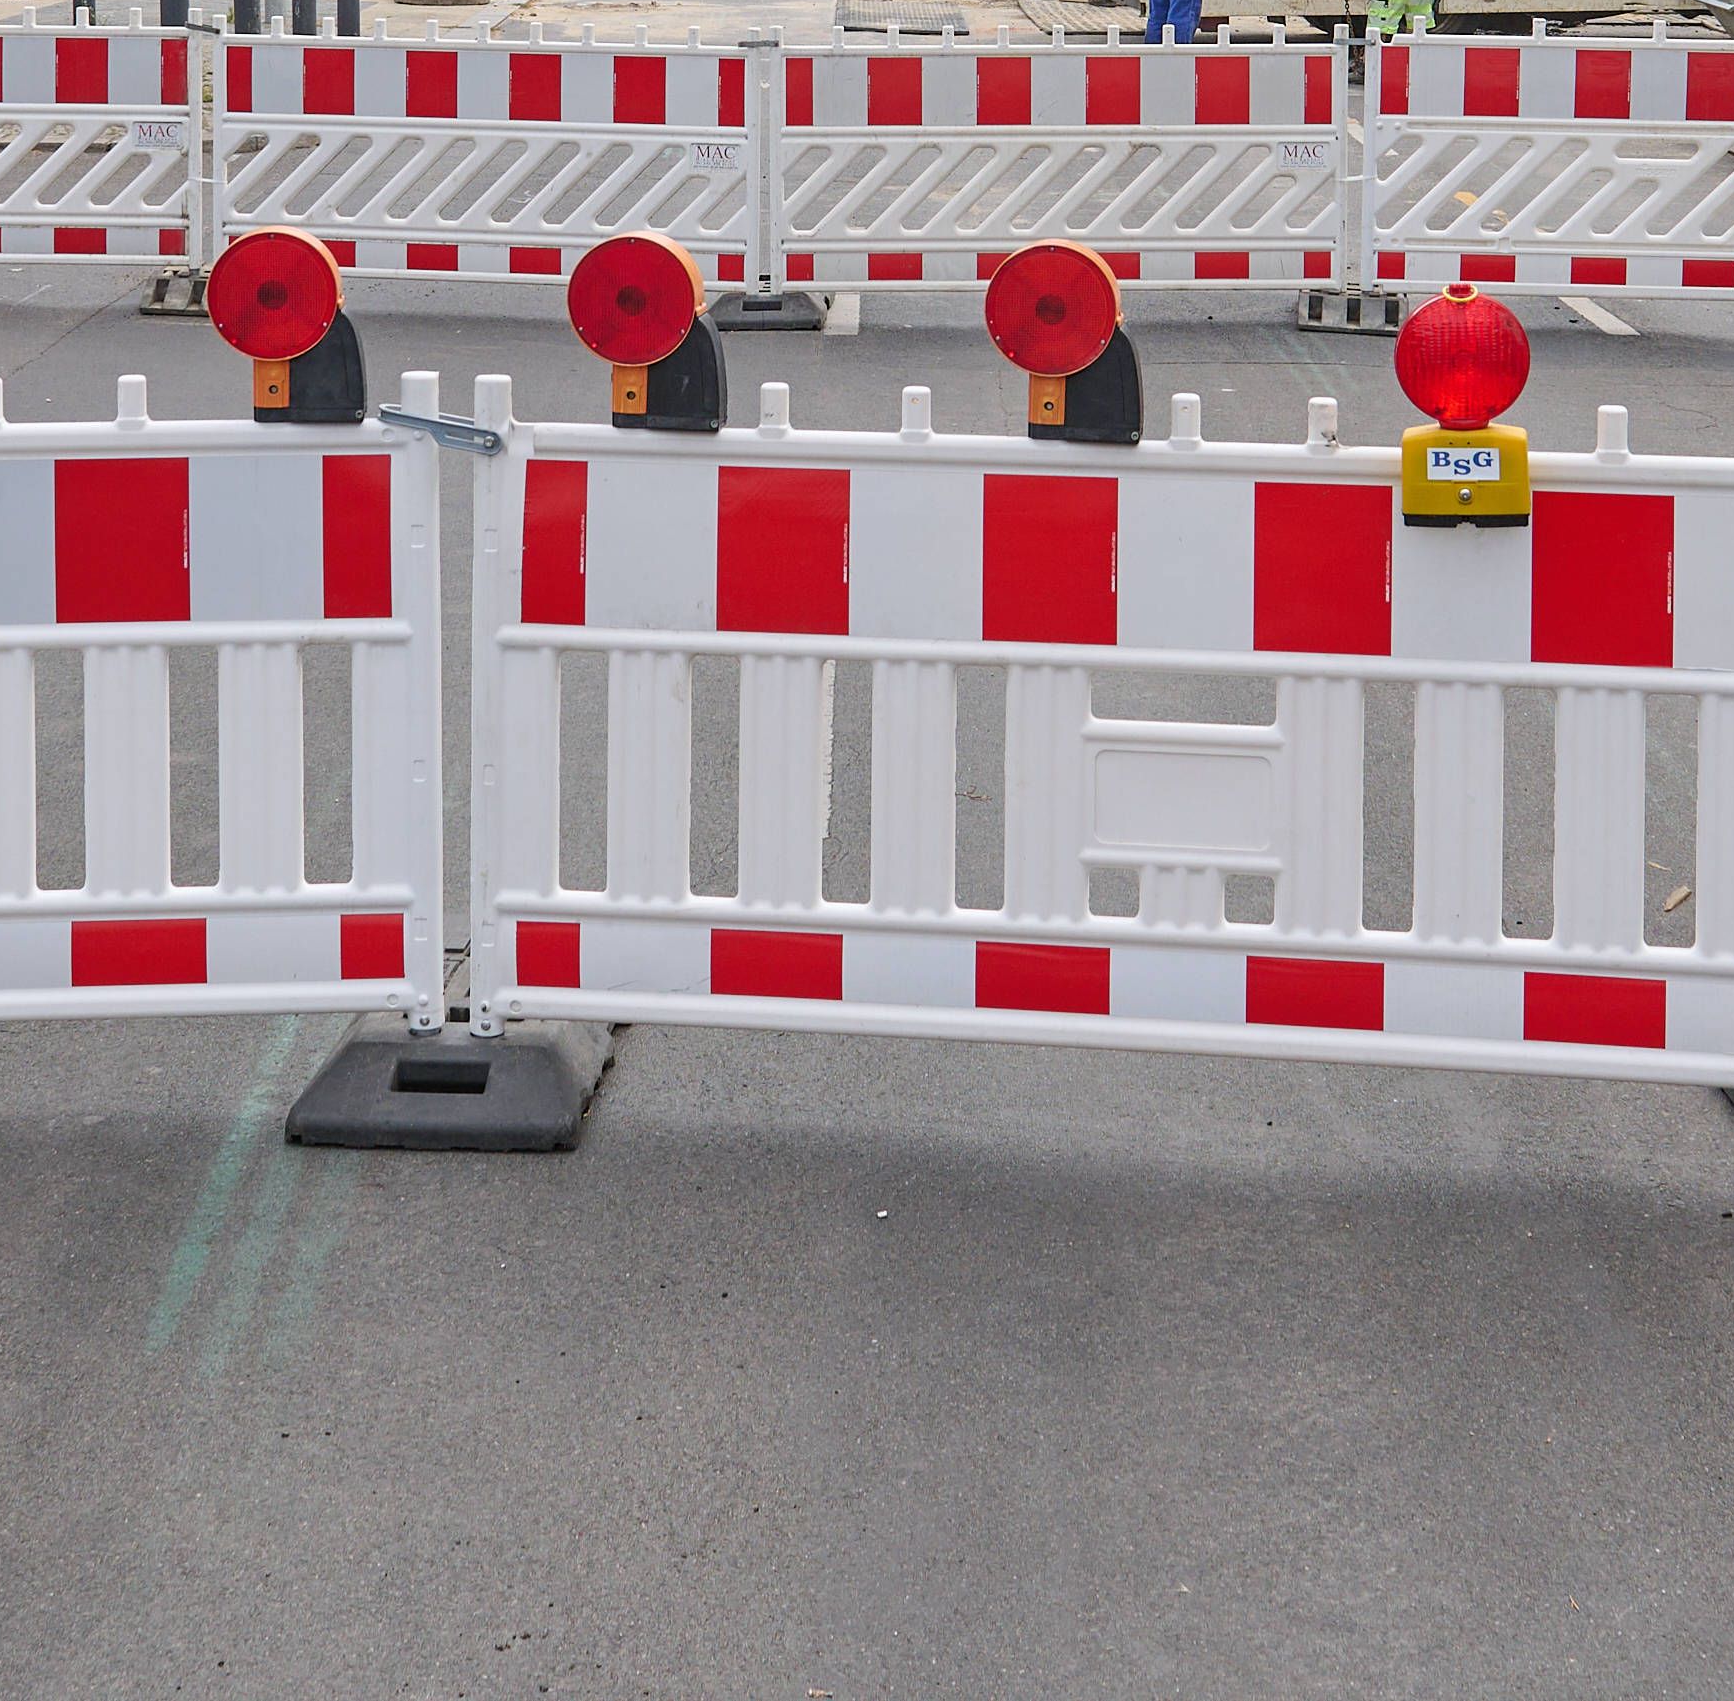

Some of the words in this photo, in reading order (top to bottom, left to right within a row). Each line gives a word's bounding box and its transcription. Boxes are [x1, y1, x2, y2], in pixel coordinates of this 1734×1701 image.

[138, 125, 178, 139] MAC
[697, 146, 736, 160] MAC
[1283, 145, 1323, 159] MAC
[1431, 451, 1494, 476] BSG
